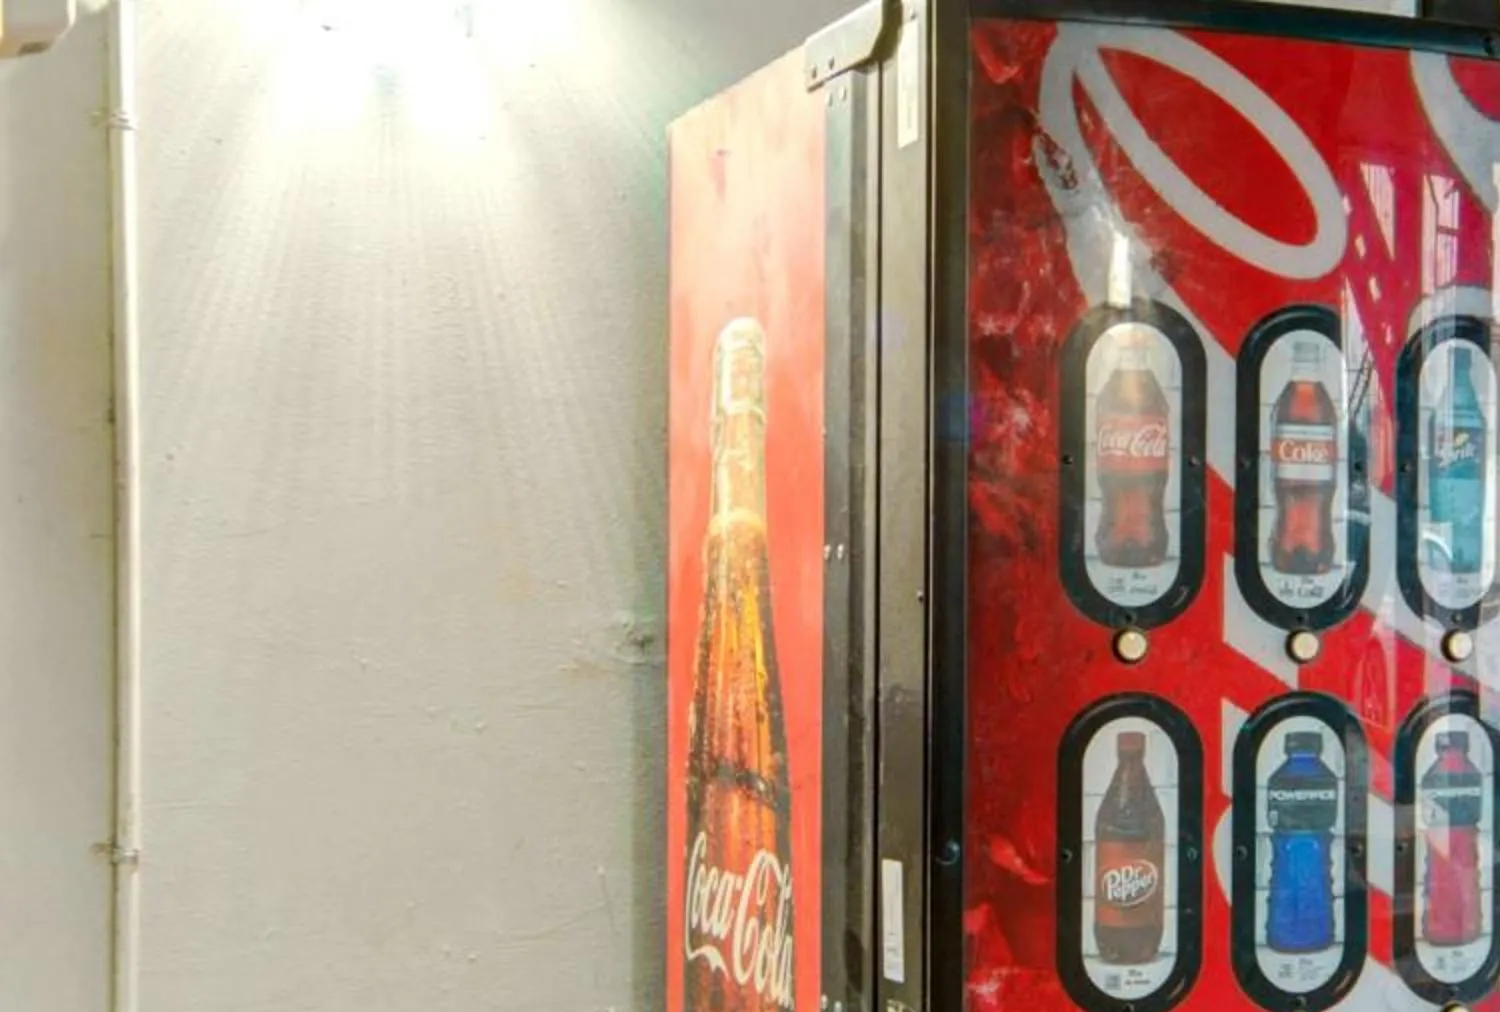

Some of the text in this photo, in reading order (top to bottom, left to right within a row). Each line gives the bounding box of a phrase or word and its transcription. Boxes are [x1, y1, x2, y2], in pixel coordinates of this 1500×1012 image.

[1278, 439, 1330, 463] Coke
[1103, 869, 1153, 901] Pepper
[1121, 865, 1144, 882] Dr
[686, 831, 793, 1010] Coca-Cola
